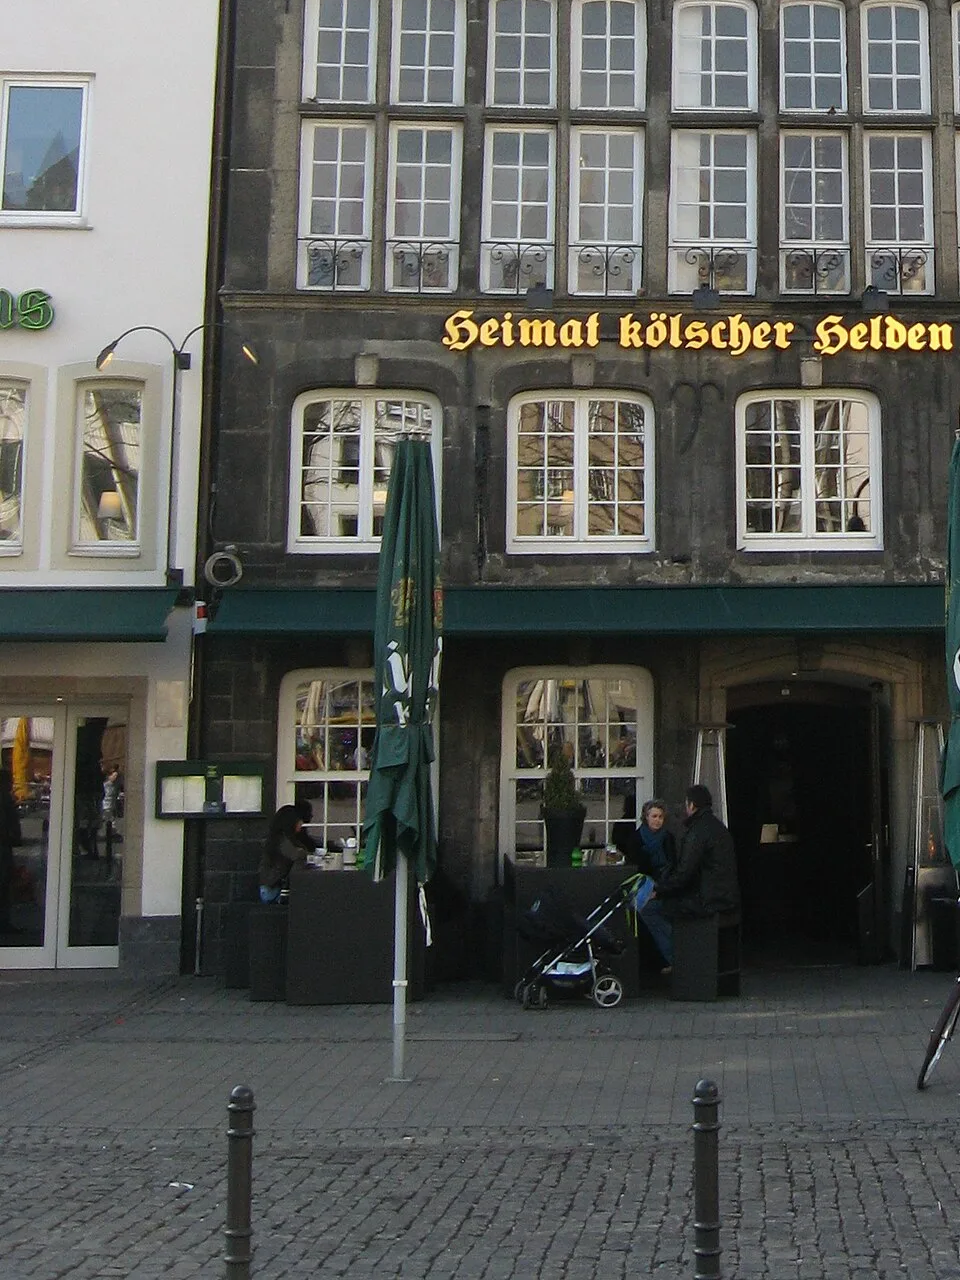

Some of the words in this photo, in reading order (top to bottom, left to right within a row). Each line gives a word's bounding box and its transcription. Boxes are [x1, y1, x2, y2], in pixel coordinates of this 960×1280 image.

[441, 310, 600, 351] Heimat
[619, 312, 794, 356] kölscher
[813, 314, 953, 355] Helden
